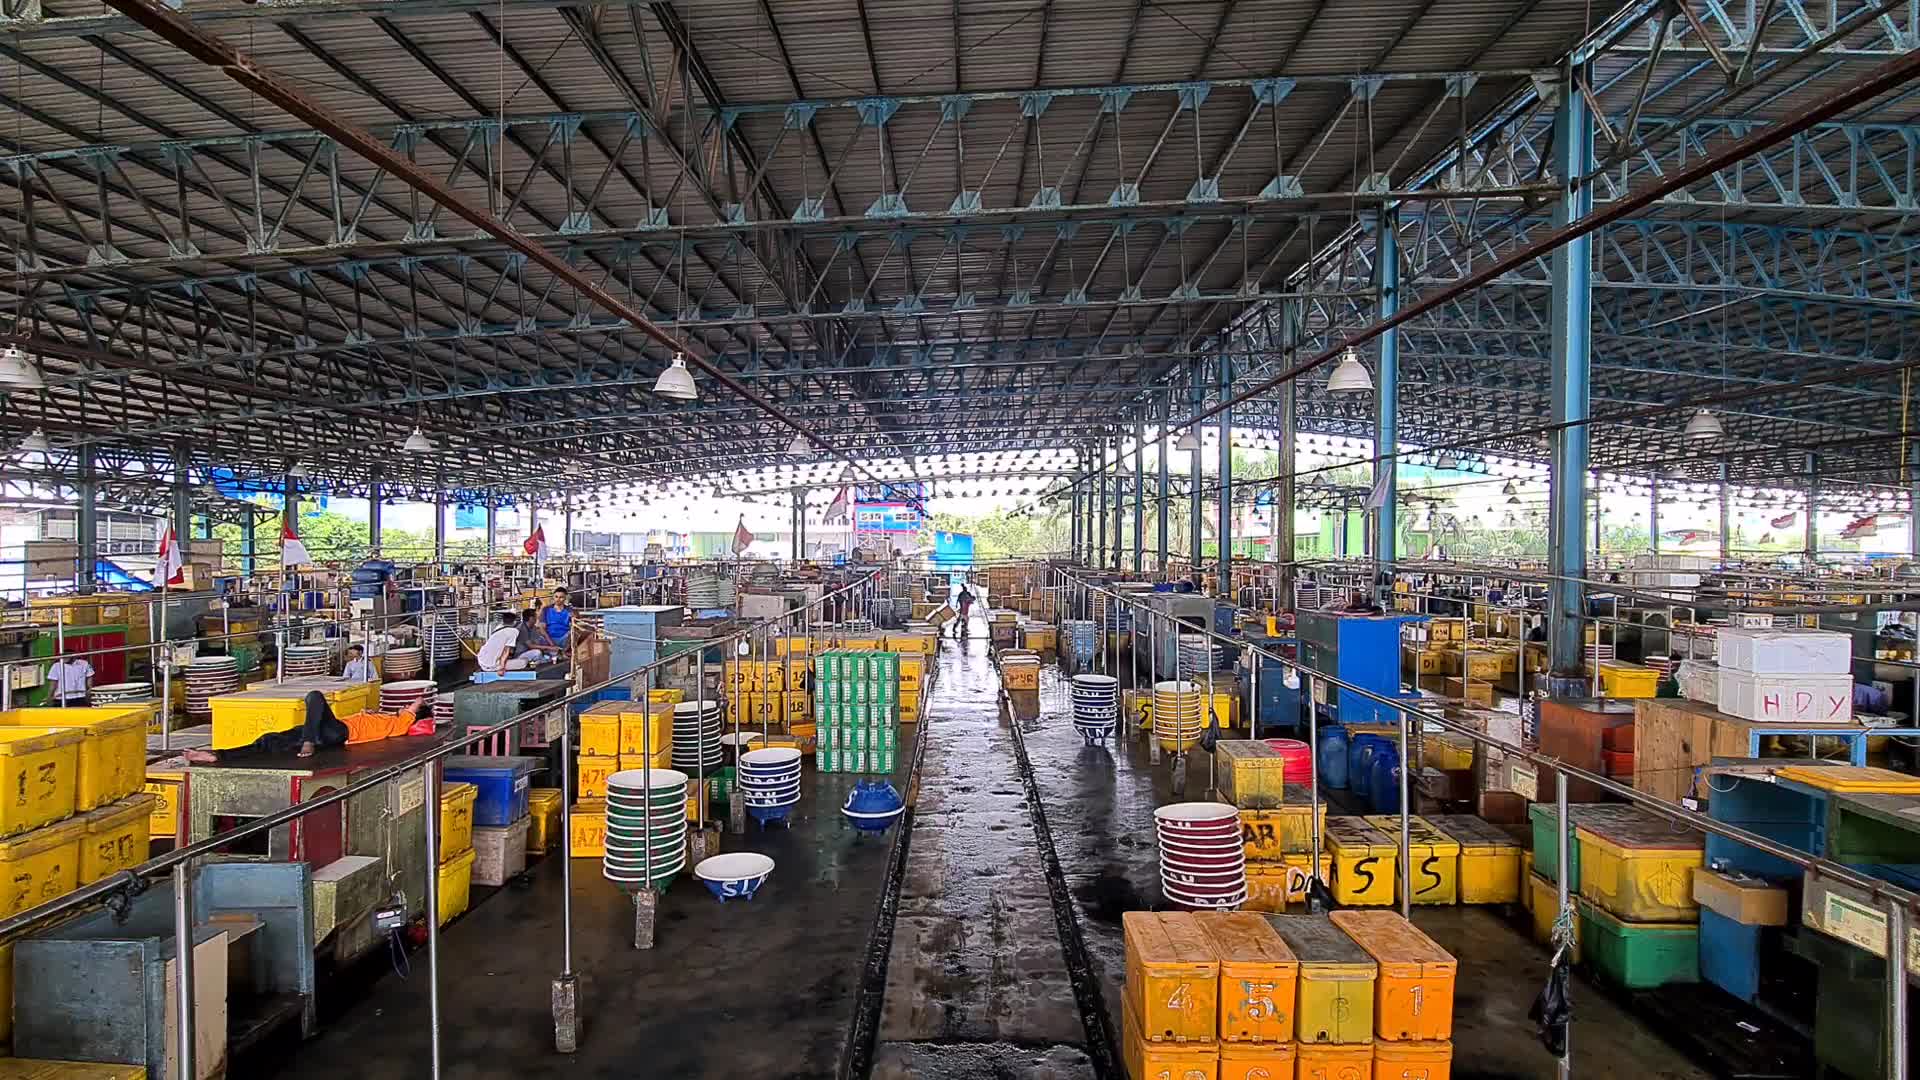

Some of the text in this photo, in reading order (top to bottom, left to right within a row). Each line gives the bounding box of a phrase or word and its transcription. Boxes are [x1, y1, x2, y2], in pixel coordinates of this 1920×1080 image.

[1352, 856, 1379, 894] S
[1415, 856, 1442, 895] S
[1247, 982, 1275, 1022] 5
[1409, 985, 1424, 1016] 1
